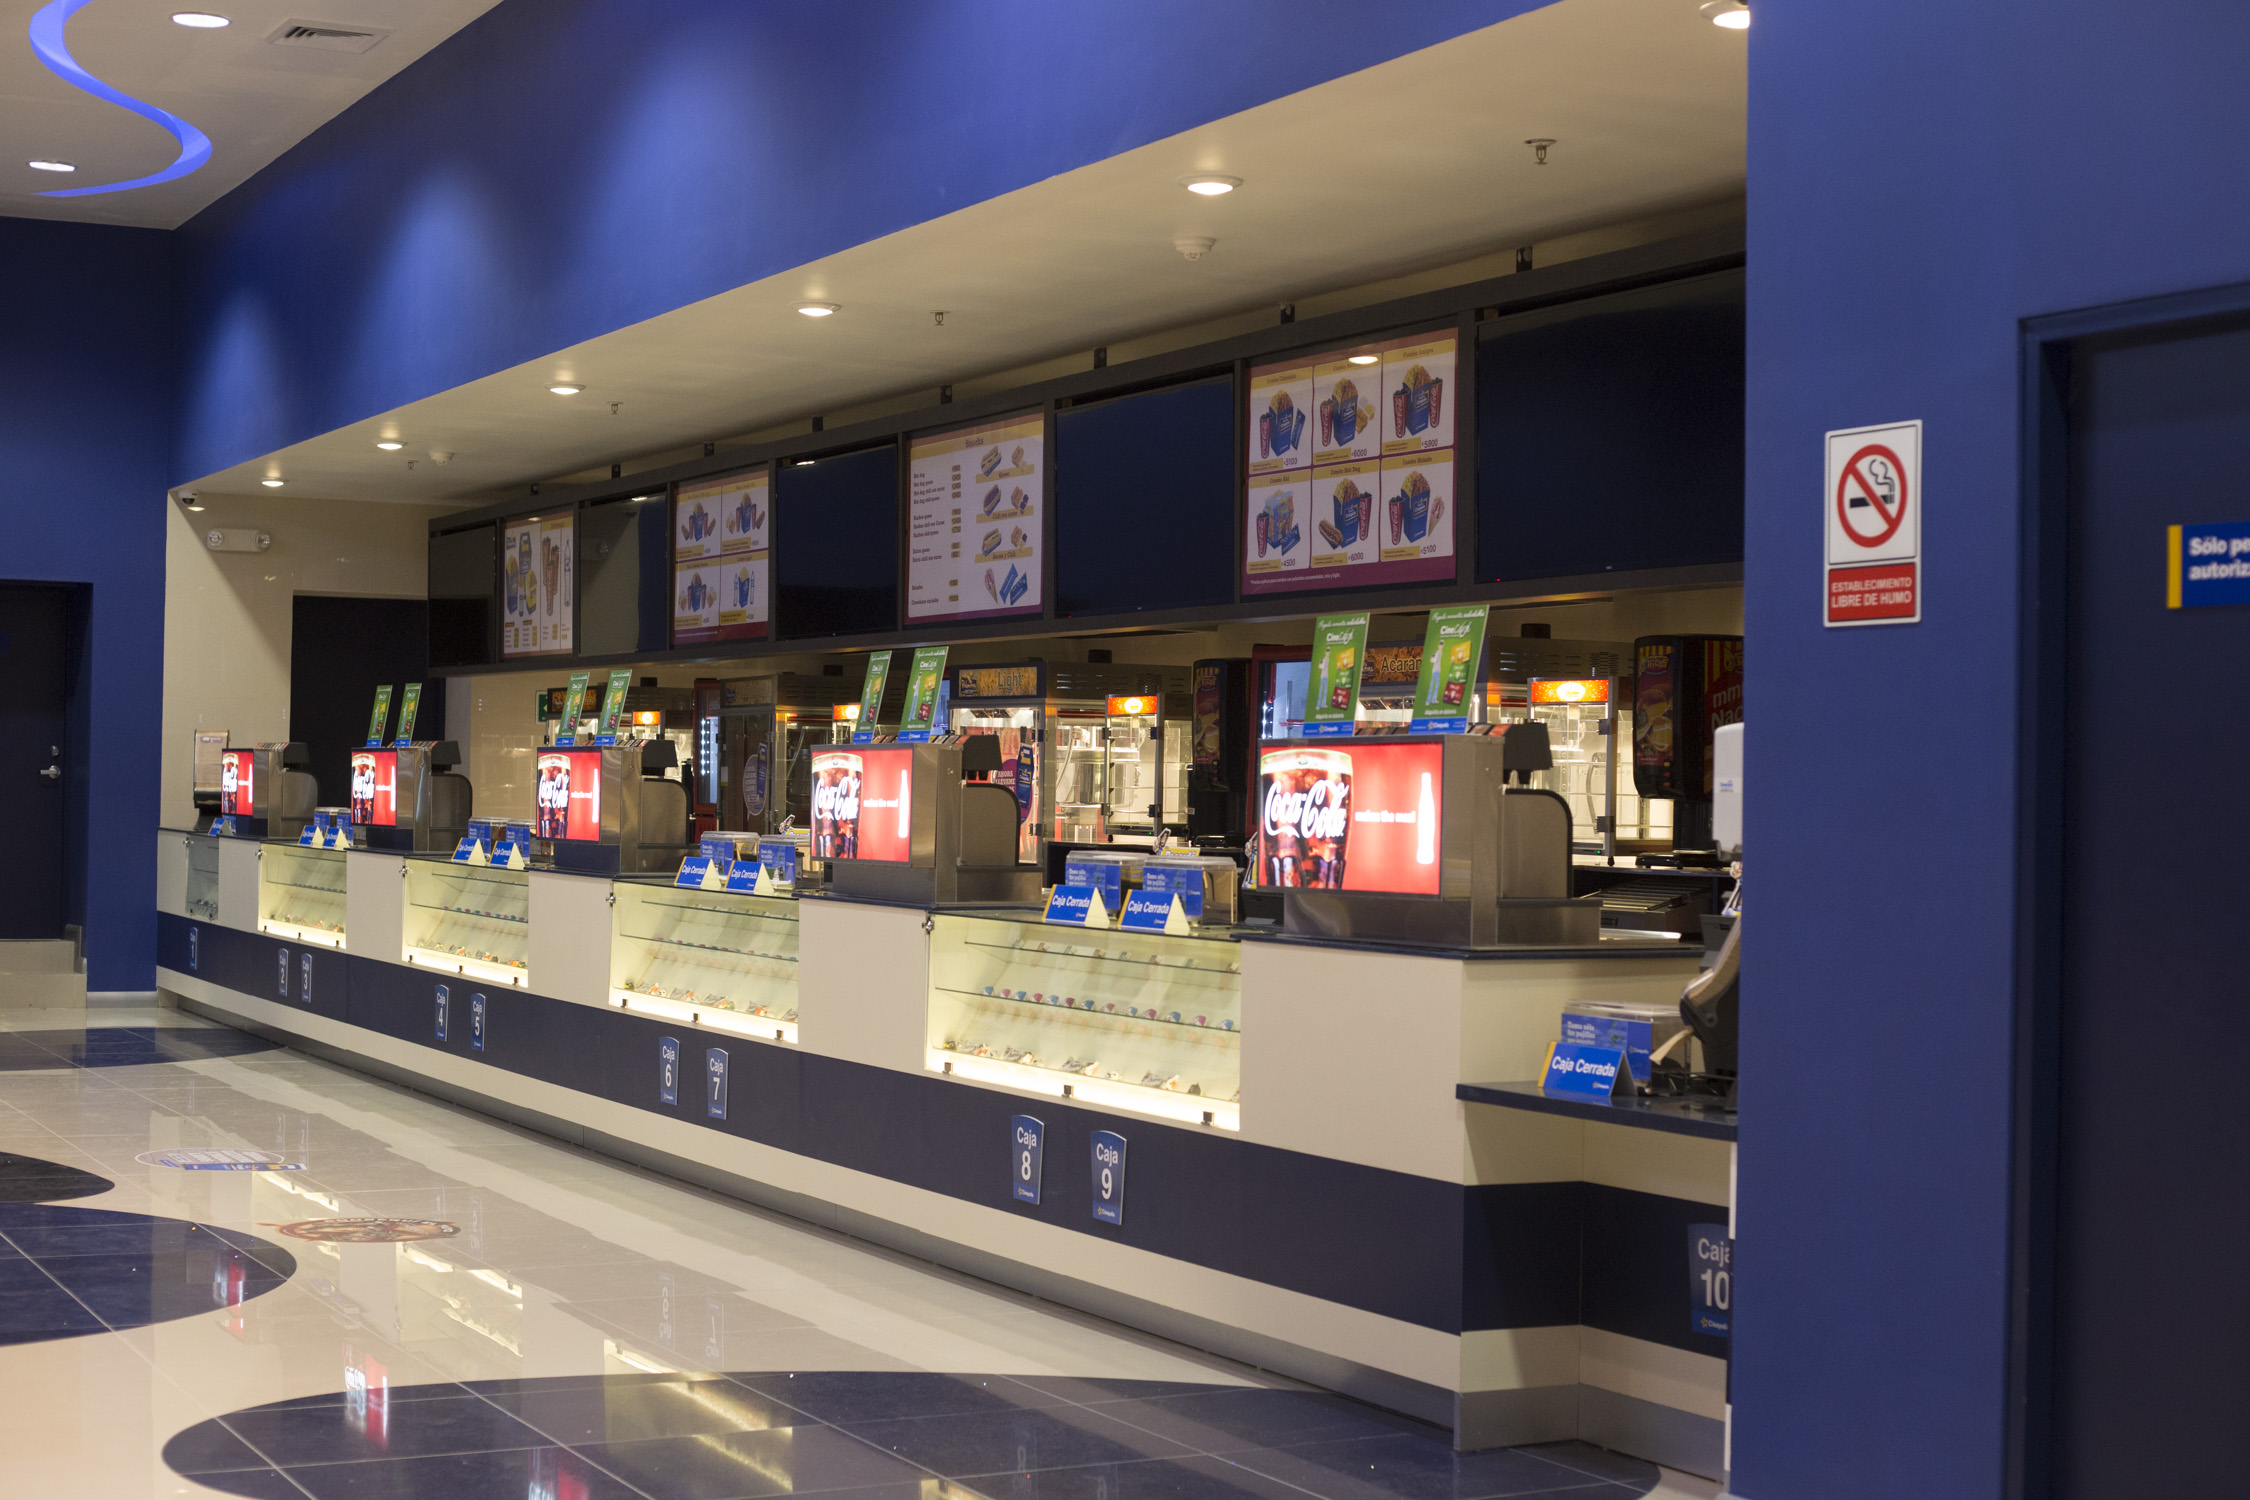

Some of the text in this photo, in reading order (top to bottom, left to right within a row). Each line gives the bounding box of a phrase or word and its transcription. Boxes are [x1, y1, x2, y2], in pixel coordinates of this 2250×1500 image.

[965, 437, 984, 448] Snacks
[2189, 535, 2228, 557] Sólo
[1831, 577, 1913, 593] ESTABLECIMIENTO
[1831, 591, 1912, 608] LIBRE DE HUMO
[997, 671, 1023, 692] Light
[539, 773, 569, 809] Coca-Cola
[815, 776, 860, 821] Coca-Cola
[1265, 779, 1349, 839] Coca-Cola
[681, 865, 707, 875] Caja Cerrada
[731, 869, 758, 880] Caja Cerrada
[1051, 894, 1090, 908] Caja Cerrada
[1127, 900, 1170, 915] Caja Cerrada
[280, 968, 285, 984] 2
[303, 973, 308, 990] 3
[438, 1007, 443, 1027] 4
[475, 1016, 480, 1037] 5
[662, 1045, 675, 1063] Caja
[665, 1063, 672, 1087] 6
[709, 1058, 724, 1076] Caja
[1551, 1055, 1616, 1077] Caja Cerrada
[713, 1076, 720, 1100] 7
[1016, 1126, 1037, 1150] Caja
[1021, 1150, 1031, 1181] 8
[1096, 1143, 1118, 1167] Caja
[1101, 1168, 1112, 1200] 9
[1698, 1237, 1730, 1268] Caja
[1700, 1268, 1730, 1311] 10
